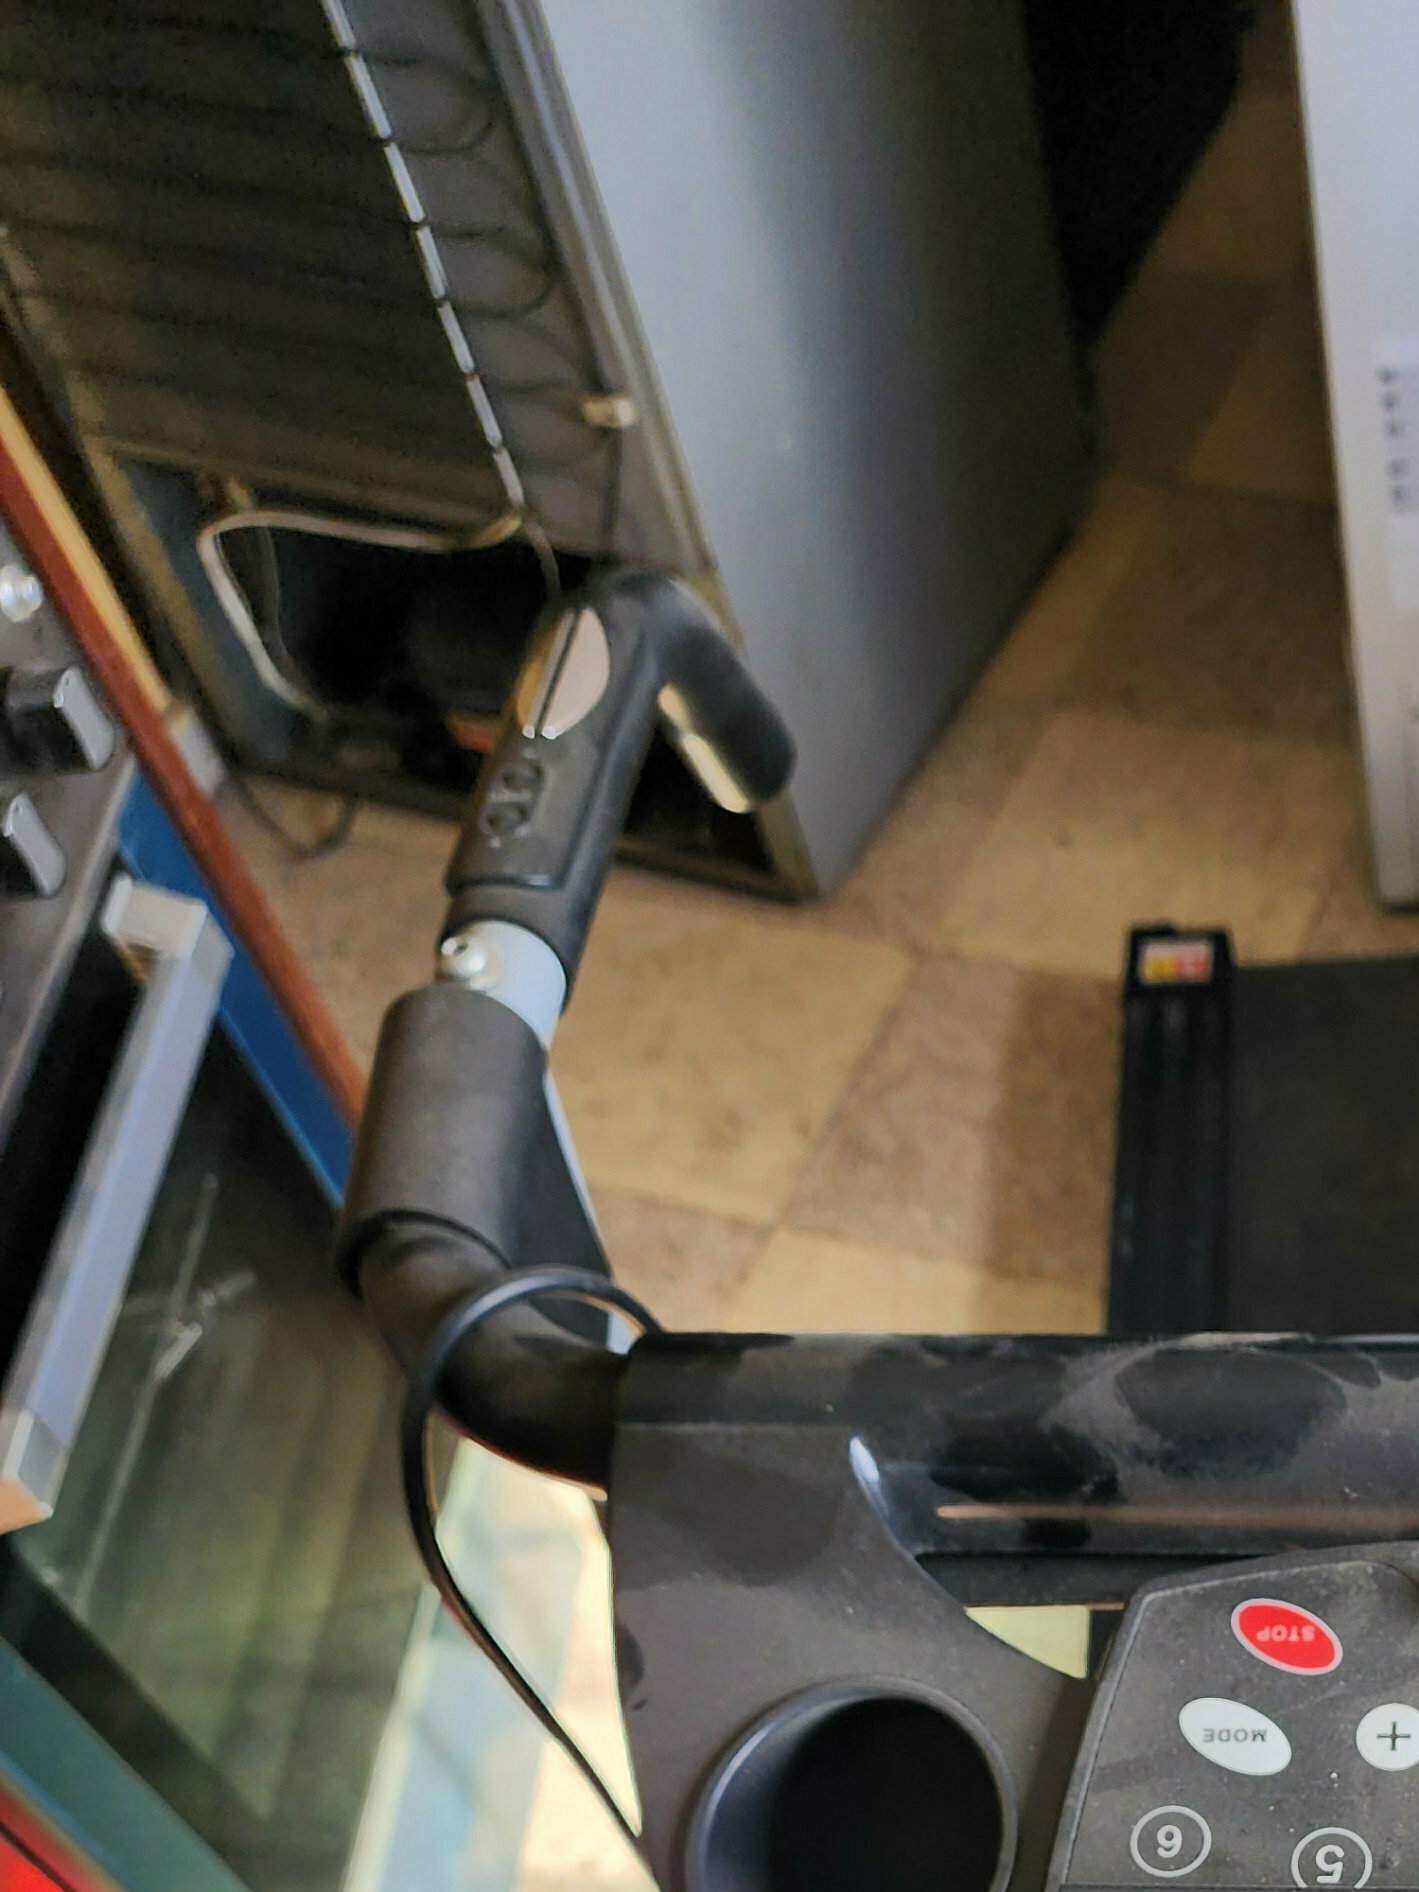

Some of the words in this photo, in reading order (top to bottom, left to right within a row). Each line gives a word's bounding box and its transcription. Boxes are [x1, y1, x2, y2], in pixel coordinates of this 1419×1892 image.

[1256, 1625, 1315, 1642] STOP
[1203, 1728, 1267, 1743] MODE
[1157, 1824, 1182, 1858] 6
[1315, 1844, 1345, 1884] 5
